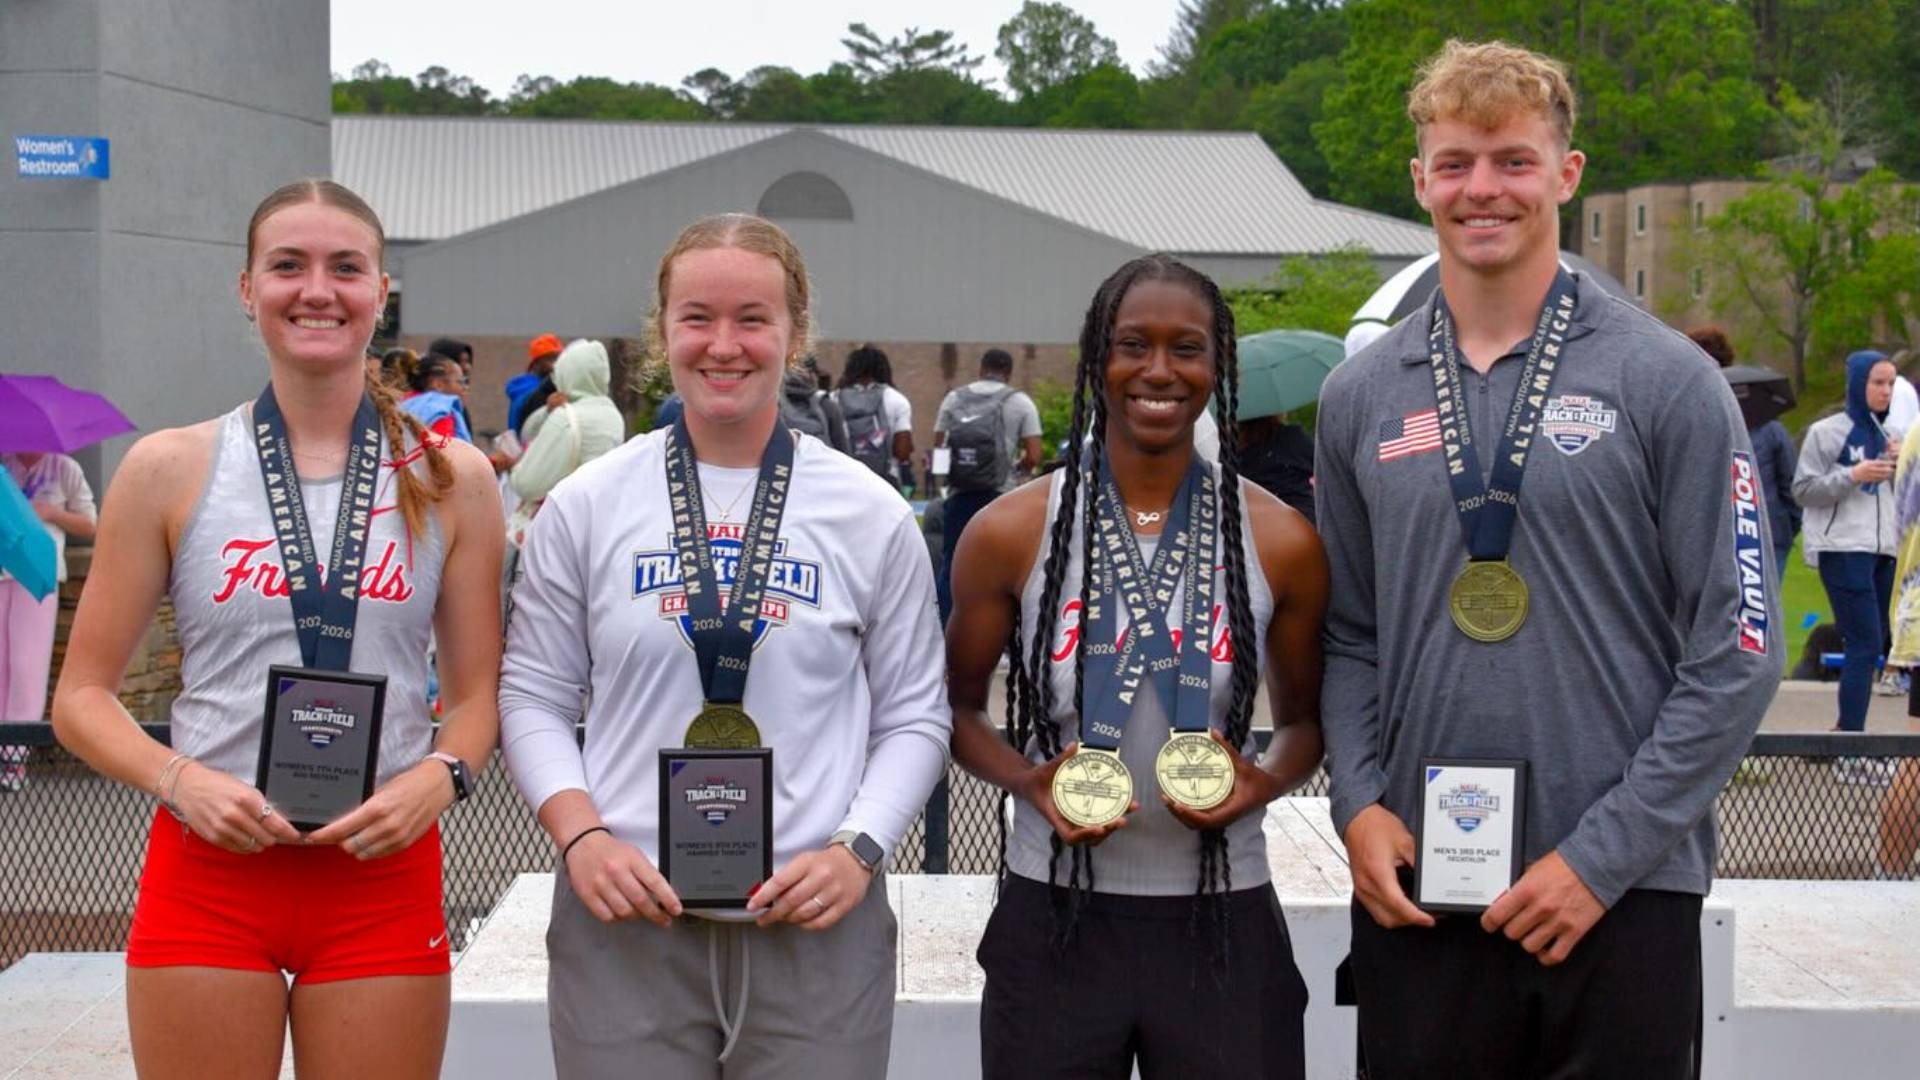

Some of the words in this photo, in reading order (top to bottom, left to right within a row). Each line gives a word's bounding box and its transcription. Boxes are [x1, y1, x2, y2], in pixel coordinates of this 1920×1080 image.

[16, 138, 74, 155] Women's
[19, 158, 80, 174] Restroom
[1506, 414, 1519, 437] NAIA
[1513, 364, 1534, 413] OUTDOOR
[1527, 336, 1544, 364] TRACK
[1540, 306, 1553, 329] FIELD
[1510, 294, 1574, 467] ALL-AMERICAN
[1543, 409, 1574, 422] RACK
[1580, 411, 1612, 427] FIELD
[282, 459, 300, 505] OUTDOOR
[685, 468, 700, 511] OUTDOOR
[1488, 489, 1517, 505] 2026
[257, 422, 307, 591] ALL-AMERICAN
[1734, 457, 1758, 539] POLE
[335, 502, 351, 548] OUTDOOR
[340, 428, 378, 600] ALL-AMERICAN
[1113, 504, 1135, 550] OUTDOOR
[737, 537, 755, 580] OUTDOOR
[738, 464, 789, 633] ALL-AMERICAN
[1195, 475, 1214, 653] ALL-AMERICAN
[766, 561, 817, 599] ELD
[1185, 554, 1197, 600] OUTDOOR
[1185, 600, 1195, 624] NAIA
[1738, 548, 1766, 650] VAULT
[320, 624, 352, 640] 2026
[692, 617, 723, 631] 2026
[718, 655, 747, 671] 2026
[1086, 644, 1117, 656] 2026
[1179, 674, 1209, 690] 2026
[292, 709, 322, 722] TRACK
[328, 712, 354, 728] FIELD
[1091, 721, 1122, 739] 2026
[686, 789, 716, 801] TRACK
[720, 789, 746, 801] FIELD
[1433, 847, 1457, 855] MEN'S
[1476, 848, 1500, 857] PLACE
[1446, 855, 1487, 863] DECATHLON
